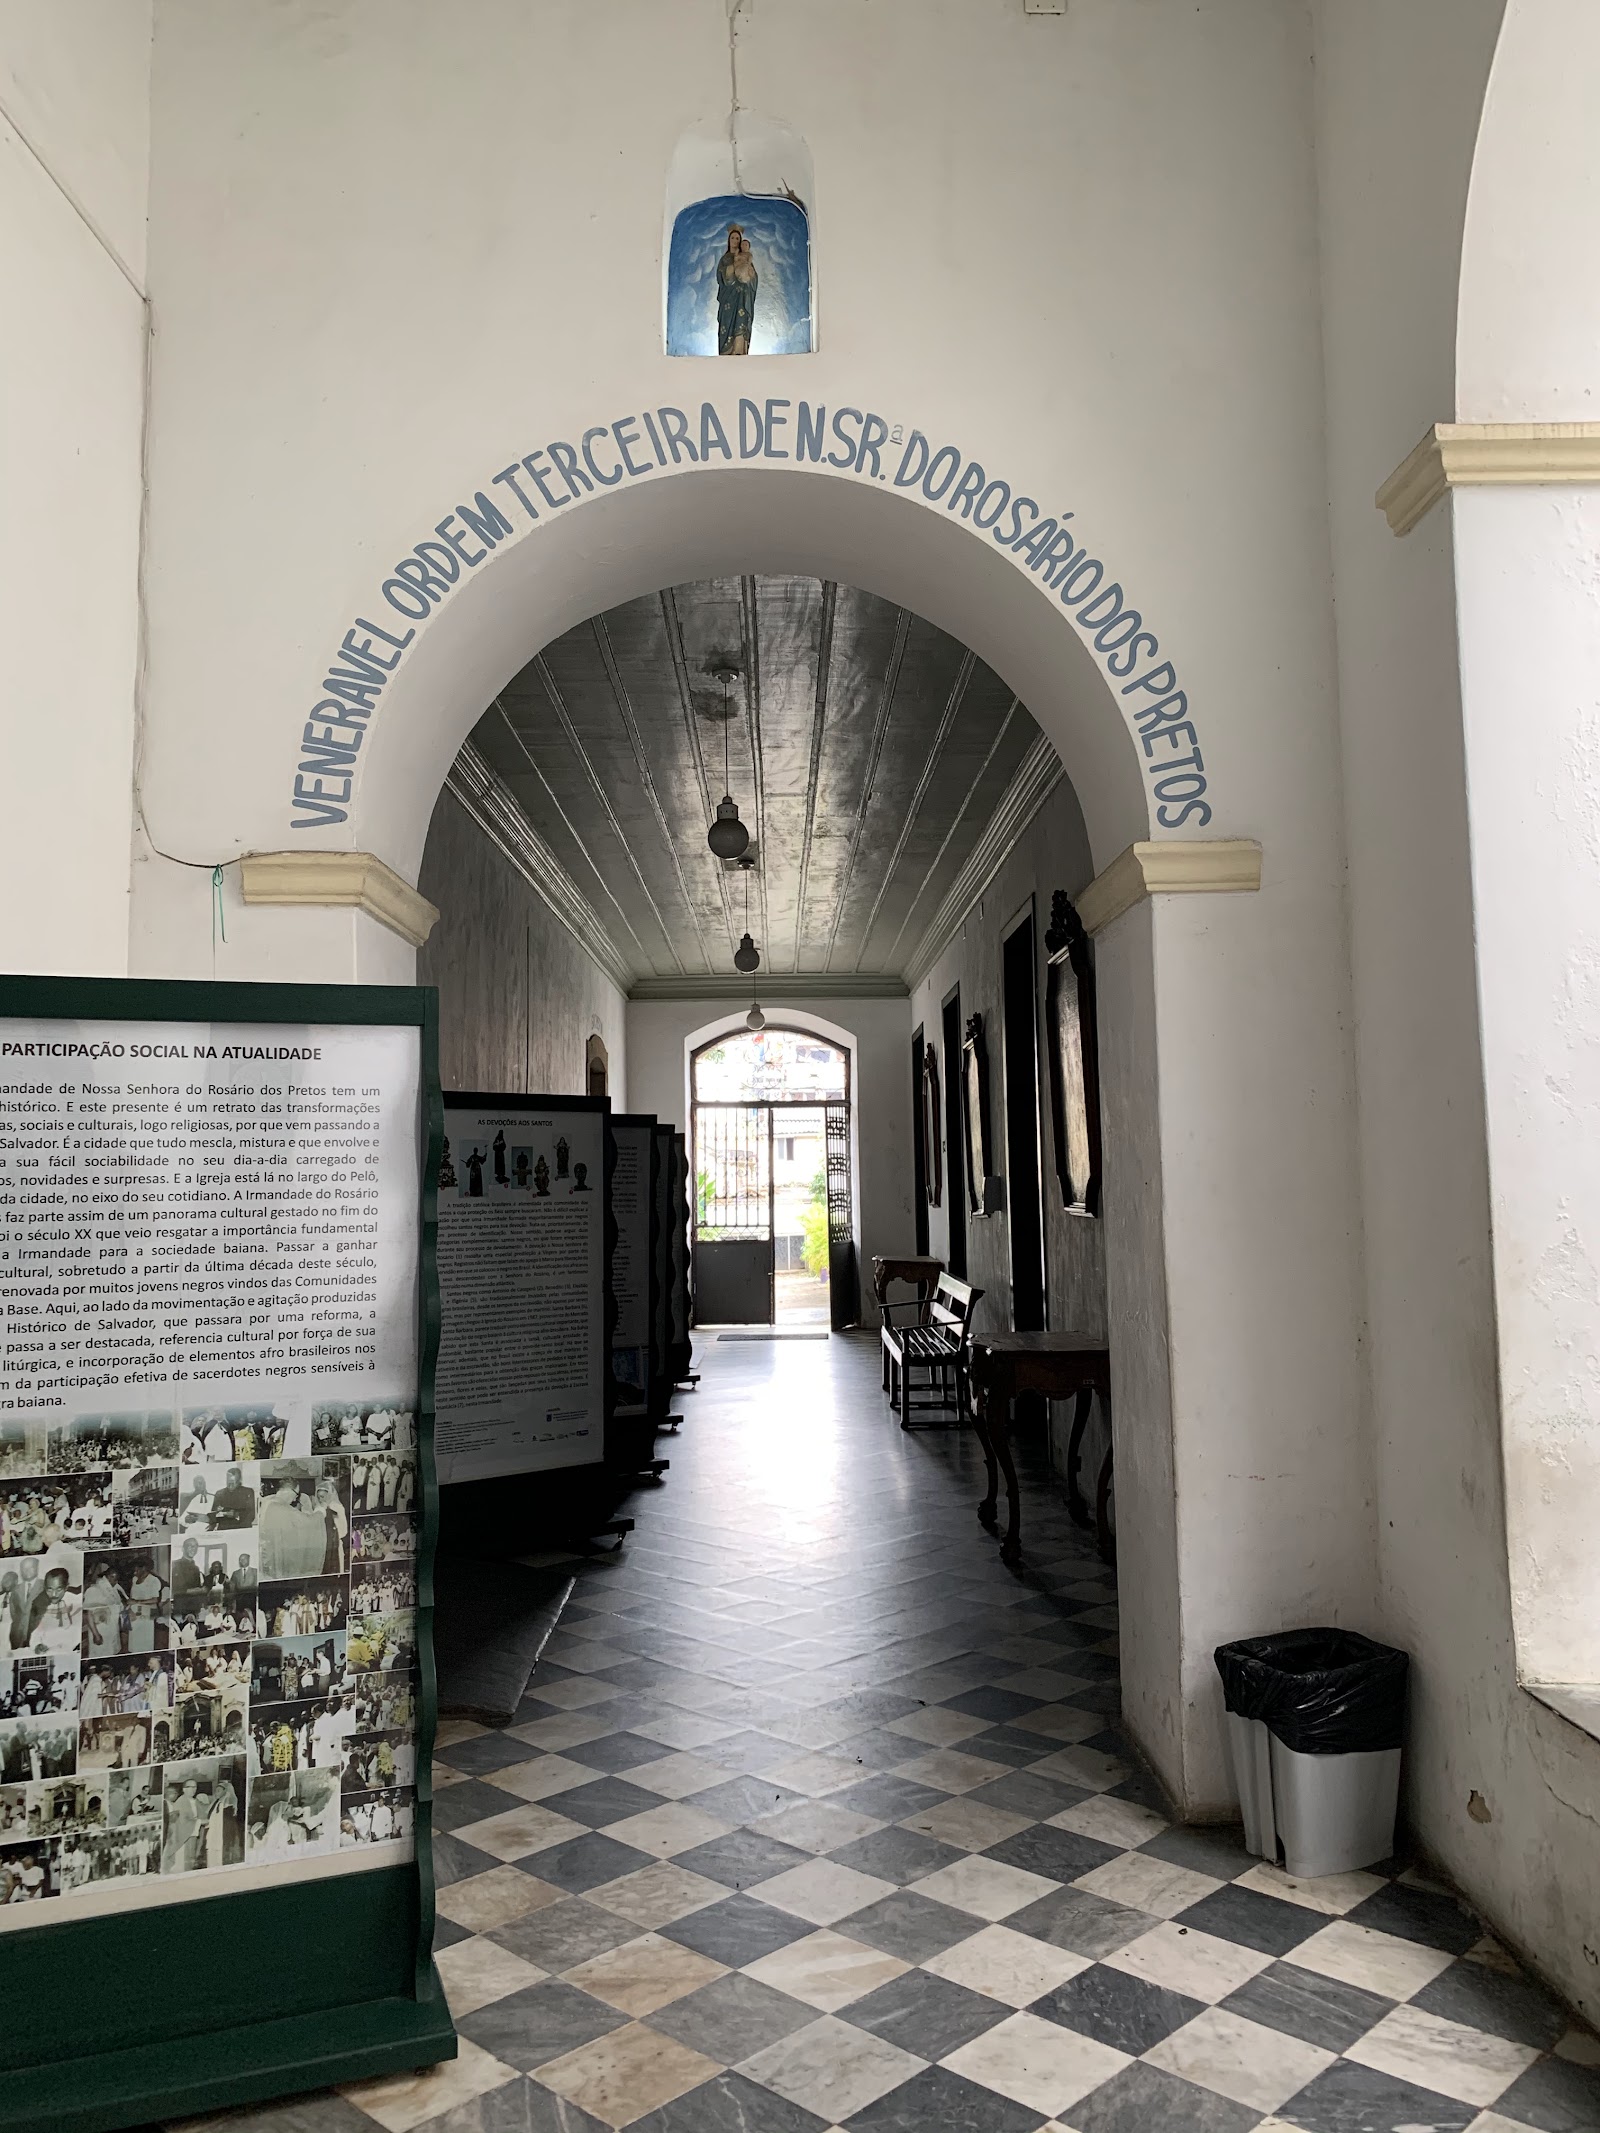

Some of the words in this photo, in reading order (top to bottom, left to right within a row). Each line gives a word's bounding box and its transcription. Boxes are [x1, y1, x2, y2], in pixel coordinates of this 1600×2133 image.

[290, 618, 416, 828] VENERAVEL
[382, 491, 513, 620] ORDEM
[492, 402, 732, 519] TERCEIRA
[738, 398, 791, 459] DE
[894, 429, 961, 501] DO
[947, 462, 1104, 606] ROSÁRIO
[1076, 582, 1159, 678] DOS
[1121, 661, 1212, 829] PRETOS
[2, 1041, 125, 1060] PARTICIPAÇÃO
[130, 1044, 189, 1058] SOCIAL
[193, 1046, 218, 1059] NA
[221, 1046, 322, 1060] ATUALIDADE
[0, 1082, 53, 1094] andade
[82, 1083, 121, 1095] Nossa
[126, 1083, 180, 1095] Senhora
[208, 1084, 255, 1095] Rosário
[260, 1084, 282, 1096] dos
[288, 1085, 326, 1096] Pretos
[332, 1087, 355, 1096] tem
[79, 1102, 107, 1113] este
[112, 1102, 169, 1115] presente
[213, 1103, 256, 1113] retrato
[260, 1102, 282, 1113] das
[286, 1102, 380, 1115] transformações
[19, 1119, 64, 1131] sociais
[77, 1119, 137, 1132] culturais,
[140, 1119, 168, 1133] logo
[171, 1119, 233, 1133] religiosas,
[236, 1122, 257, 1133] por
[259, 1122, 283, 1133] que
[285, 1122, 311, 1130] vem
[314, 1119, 371, 1132] passando
[0, 1137, 59, 1149] Salvador.
[83, 1137, 127, 1149] cidade
[129, 1140, 154, 1151] que
[156, 1137, 187, 1148] tudo
[189, 1136, 236, 1150] mescla,
[239, 1137, 286, 1148] mistura
[298, 1139, 321, 1150] que
[324, 1137, 370, 1147] envolve
[16, 1158, 39, 1168] sua
[48, 1155, 75, 1167] fácil
[84, 1155, 169, 1167] sociabilidade
[203, 1157, 225, 1166] seu
[233, 1154, 288, 1166] dia-a-dia
[296, 1154, 356, 1167] carregado
[20, 1173, 89, 1186] novidades
[103, 1175, 169, 1187] surpresas.
[196, 1172, 231, 1186] Igreja
[234, 1171, 260, 1183] está
[264, 1171, 274, 1183] lá
[297, 1171, 328, 1184] largo
[350, 1170, 379, 1183] Pelô,
[20, 1192, 68, 1205] cidade,
[92, 1192, 119, 1203] eixo
[142, 1193, 164, 1202] seu
[167, 1190, 230, 1202] cotidiano.
[246, 1188, 313, 1200] Irmandade
[335, 1188, 379, 1199] Rosário
[4, 1211, 25, 1223] faz
[28, 1211, 64, 1225] parte
[67, 1210, 104, 1222] assim
[152, 1210, 217, 1222] panorama
[220, 1206, 267, 1219] cultural
[270, 1206, 319, 1220] gestado
[340, 1205, 360, 1216] fim
[27, 1228, 70, 1241] século
[74, 1228, 92, 1240] XX
[95, 1230, 121, 1242] que
[124, 1227, 152, 1238] veio
[156, 1227, 208, 1240] resgatar
[223, 1223, 297, 1238] importância
[301, 1222, 378, 1234] fundamental
[18, 1246, 91, 1259] Irmandade
[99, 1248, 128, 1260] para
[151, 1243, 216, 1256] sociedade
[223, 1242, 268, 1254] baiana.
[276, 1242, 315, 1252] Passar
[336, 1239, 378, 1253] ganhar
[58, 1263, 126, 1277] sobretudo
[144, 1262, 180, 1277] partir
[205, 1260, 244, 1272] última
[249, 1258, 293, 1271] década
[298, 1258, 331, 1269] deste
[336, 1256, 377, 1268] século,
[63, 1285, 86, 1297] por
[89, 1282, 134, 1294] muitos
[136, 1281, 179, 1295] jovens
[182, 1281, 225, 1293] negros
[227, 1277, 268, 1289] vindos
[271, 1276, 292, 1288] das
[295, 1273, 377, 1287] Comunidades
[7, 1304, 43, 1316] Base.
[45, 1302, 80, 1316] Aqui,
[82, 1303, 99, 1313] ao
[102, 1299, 130, 1312] lado
[151, 1295, 245, 1310] movimentação
[257, 1293, 309, 1308] agitação
[311, 1291, 377, 1306] produzidas
[7, 1321, 67, 1334] Histórico
[97, 1317, 156, 1330] Salvador,
[163, 1318, 188, 1330] que
[195, 1316, 242, 1329] passara
[249, 1314, 271, 1326] por
[277, 1313, 304, 1323] uma
[311, 1309, 363, 1321] reforma,
[6, 1342, 44, 1355] passa
[60, 1341, 82, 1350] ser
[85, 1335, 155, 1349] destacada,
[159, 1332, 223, 1346] referencia
[227, 1329, 274, 1343] cultural
[278, 1331, 299, 1343] por
[303, 1327, 333, 1341] força
[355, 1327, 376, 1337] sua
[3, 1358, 61, 1373] litúrgica,
[79, 1353, 164, 1369] incorporação
[189, 1350, 255, 1362] elementos
[259, 1347, 285, 1359] afro
[289, 1344, 351, 1357] brasileiros
[355, 1345, 376, 1354] nos
[37, 1373, 119, 1391] participação
[124, 1371, 167, 1384] efetiva
[193, 1366, 261, 1380] sacerdotes
[265, 1366, 307, 1378] negros
[311, 1360, 364, 1374] sensíveis
[17, 1396, 66, 1408] baiana.
